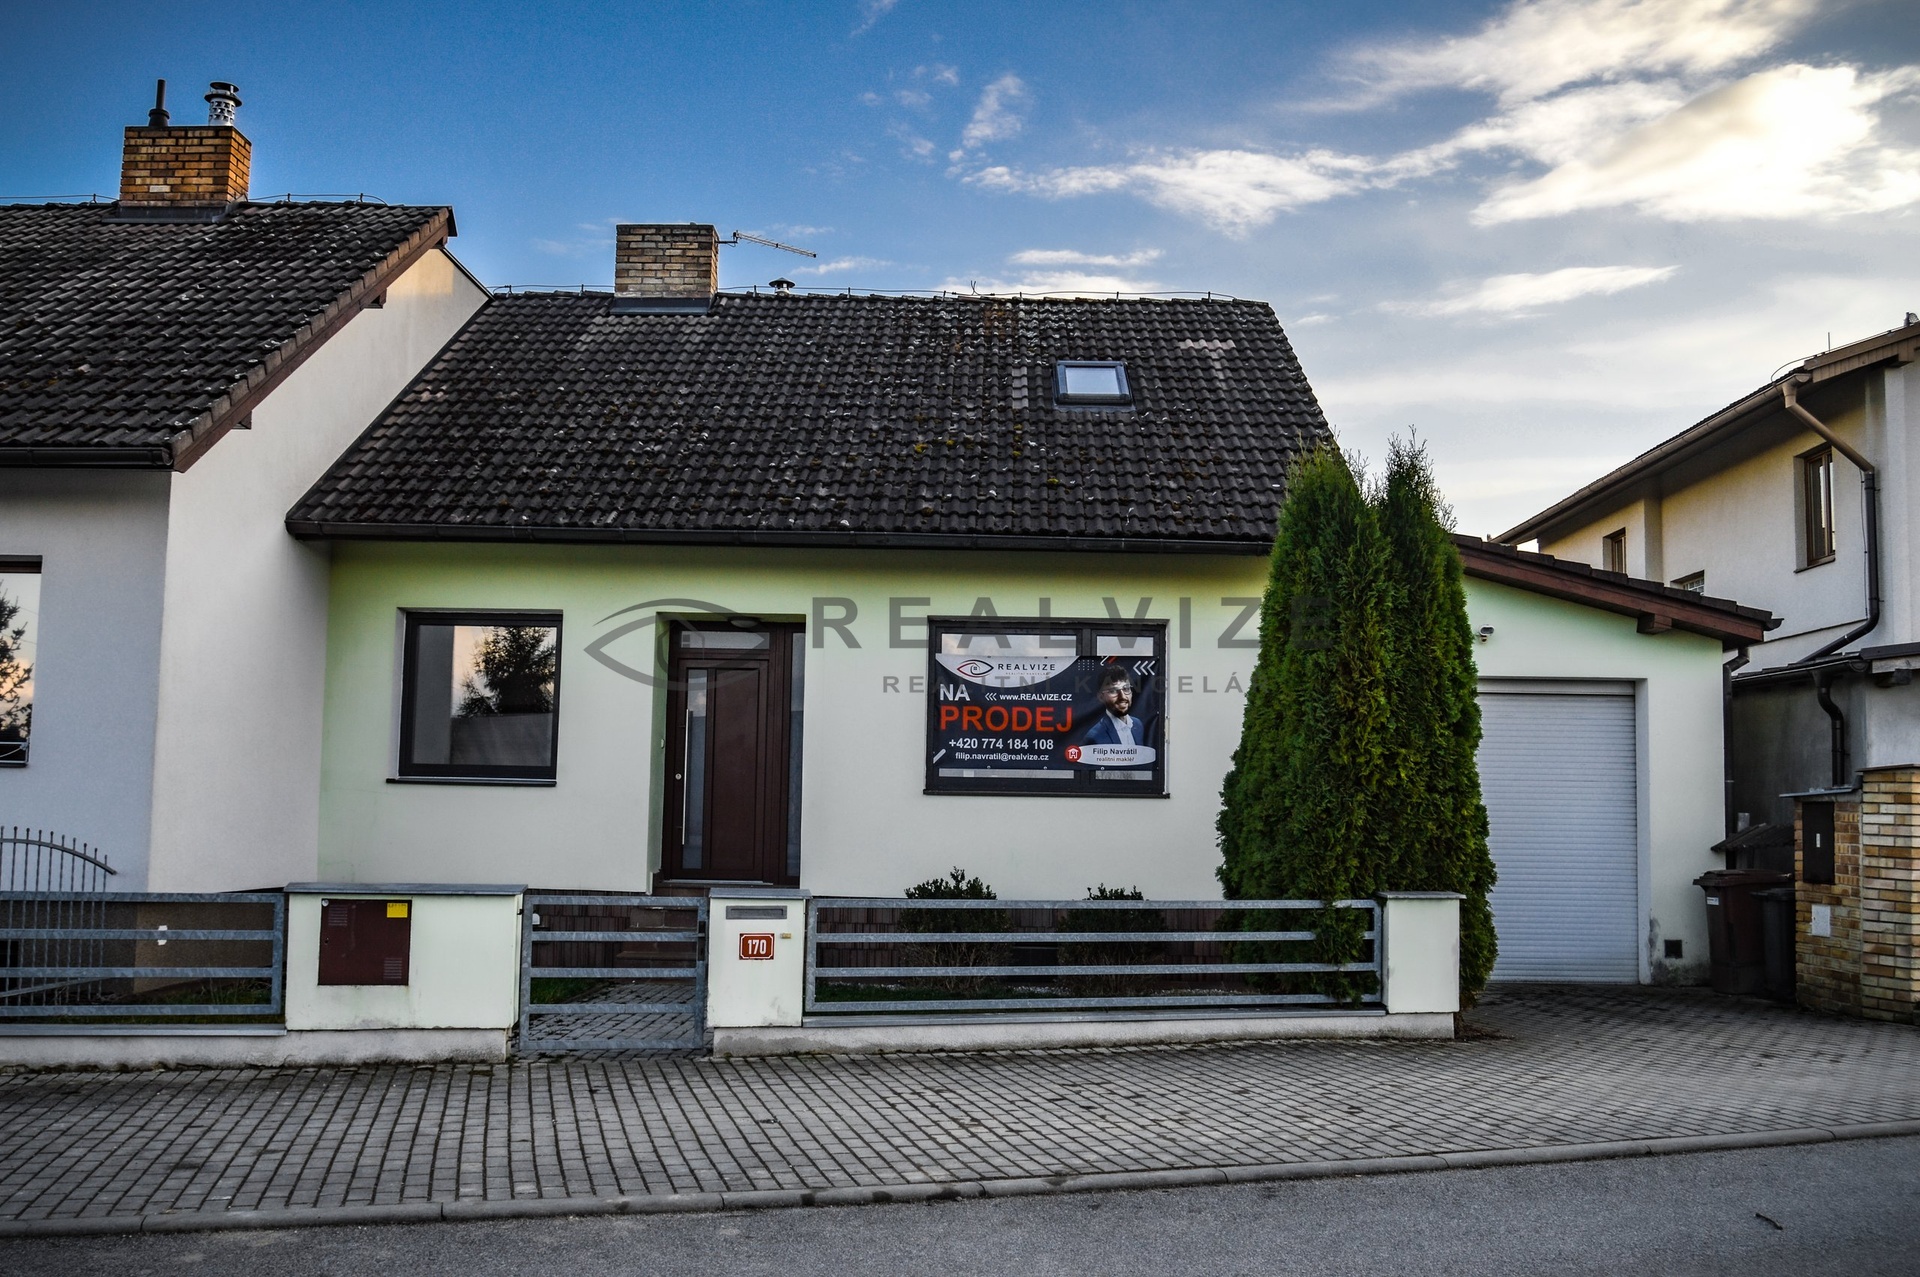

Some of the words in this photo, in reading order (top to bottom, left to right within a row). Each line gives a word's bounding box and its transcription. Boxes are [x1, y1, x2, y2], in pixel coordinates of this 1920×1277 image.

[939, 683, 971, 702] NA
[999, 693, 1073, 702] www.REALVIZE.CZ
[940, 705, 1073, 732] PRODEJ
[948, 738, 978, 749] +420
[981, 738, 1004, 749] 774
[1007, 739, 1029, 750] 184
[1032, 739, 1054, 750] 108
[955, 752, 1050, 762] filip.navratil@realvize.cz
[1092, 748, 1108, 756] Filip
[747, 938, 767, 955] 170
